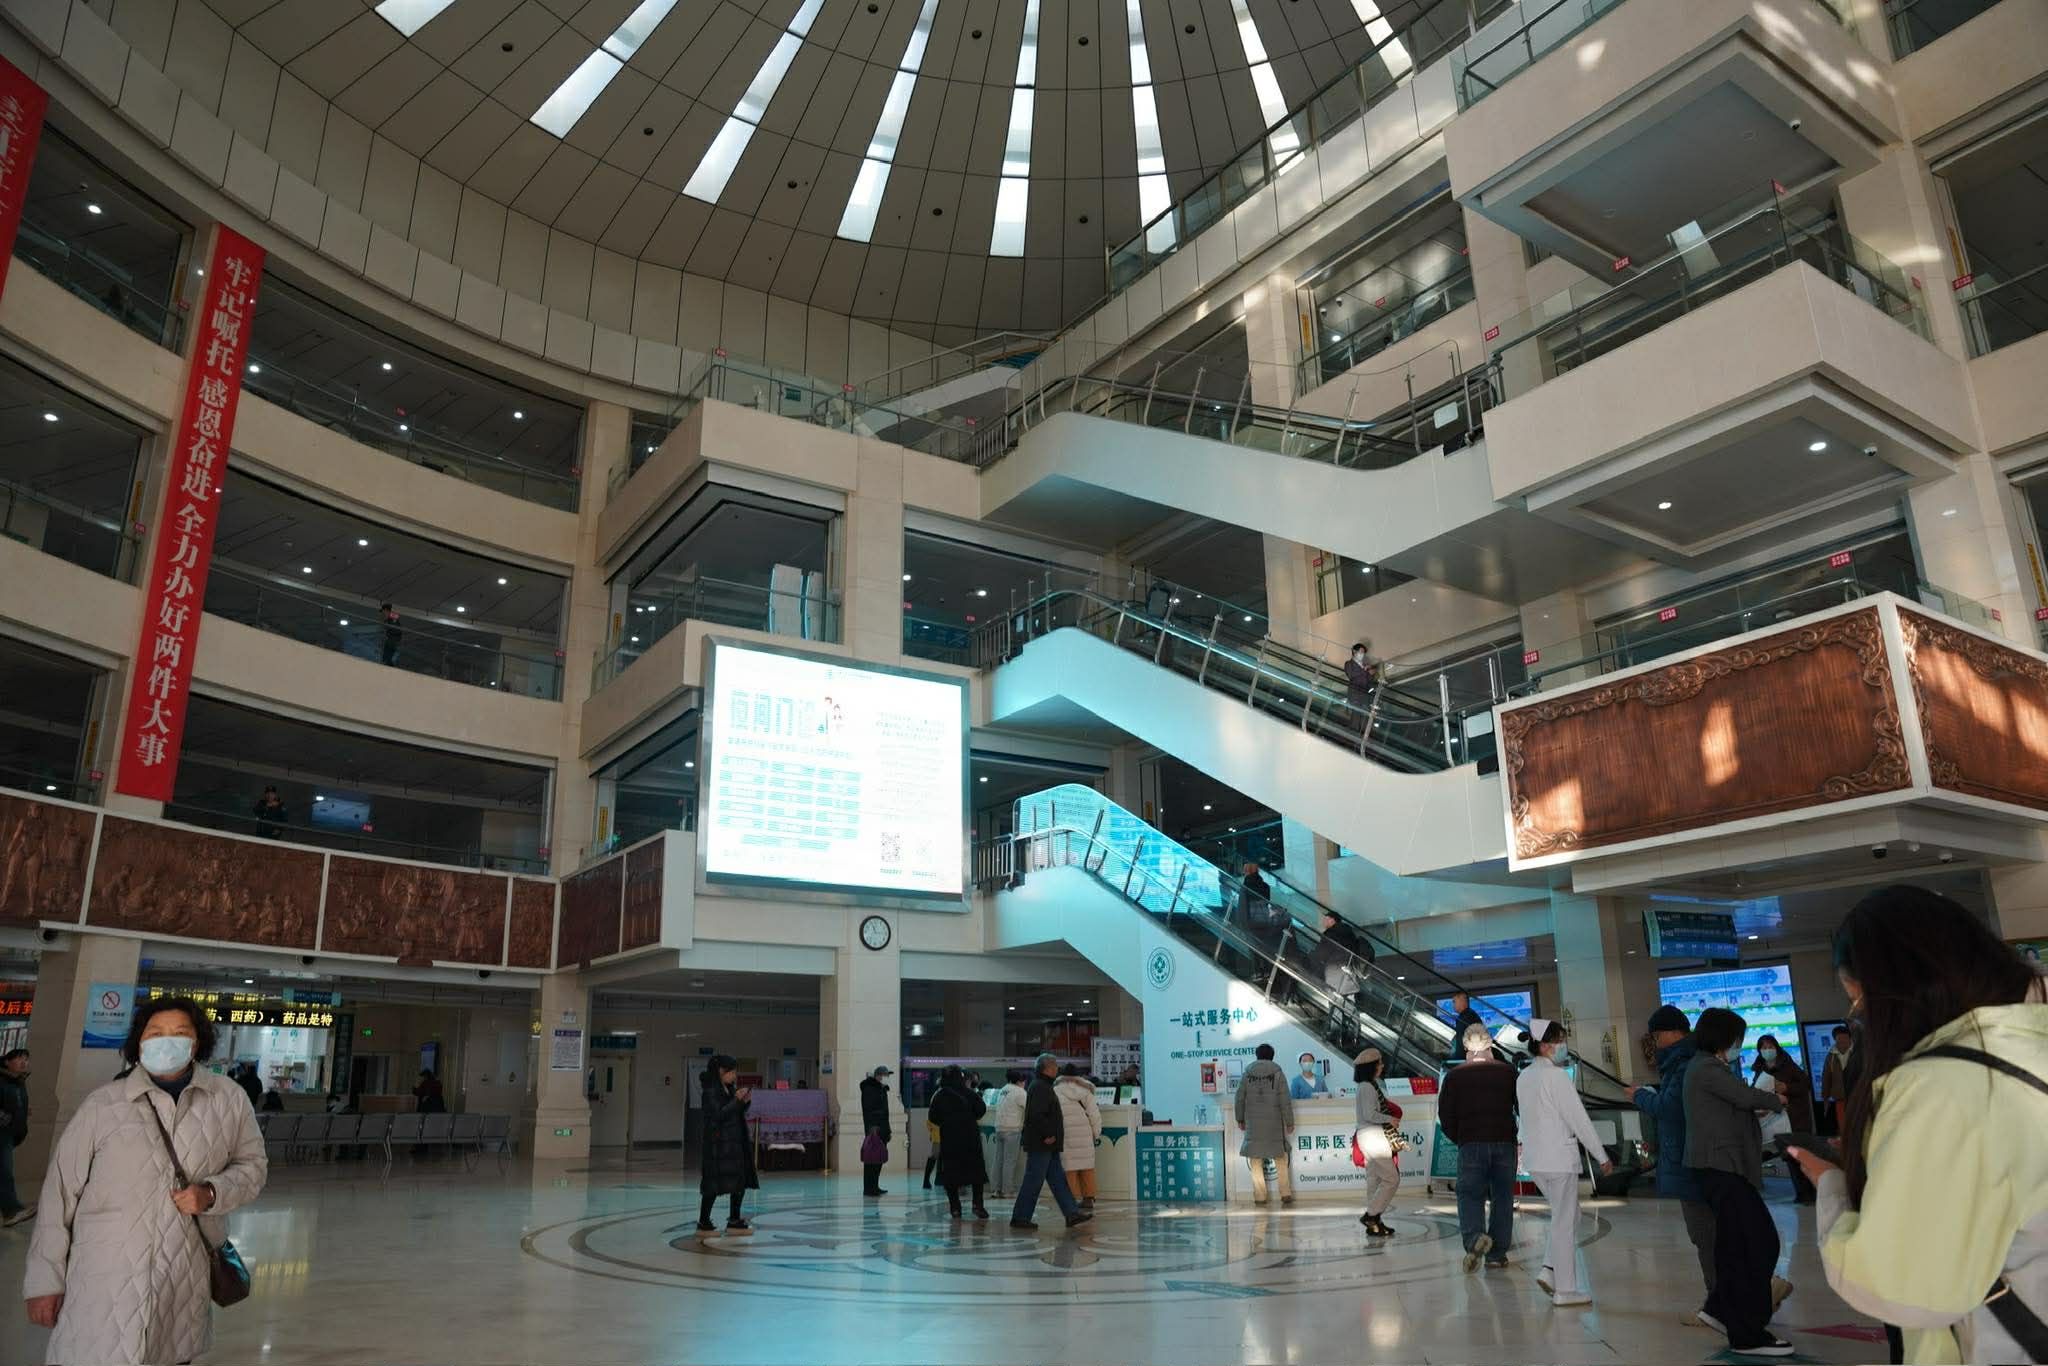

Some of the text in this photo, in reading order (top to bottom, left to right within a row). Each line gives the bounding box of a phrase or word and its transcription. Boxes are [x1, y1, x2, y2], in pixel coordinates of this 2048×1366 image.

[135, 256, 252, 767] 牢记嘱托 感恩奋进 全力办好两件大事
[1170, 1007, 1258, 1027] 一站式服务中心
[1205, 1048, 1232, 1057] SERVICE
[1233, 1047, 1256, 1056] CENTE
[1153, 1135, 1200, 1147] 服务内容
